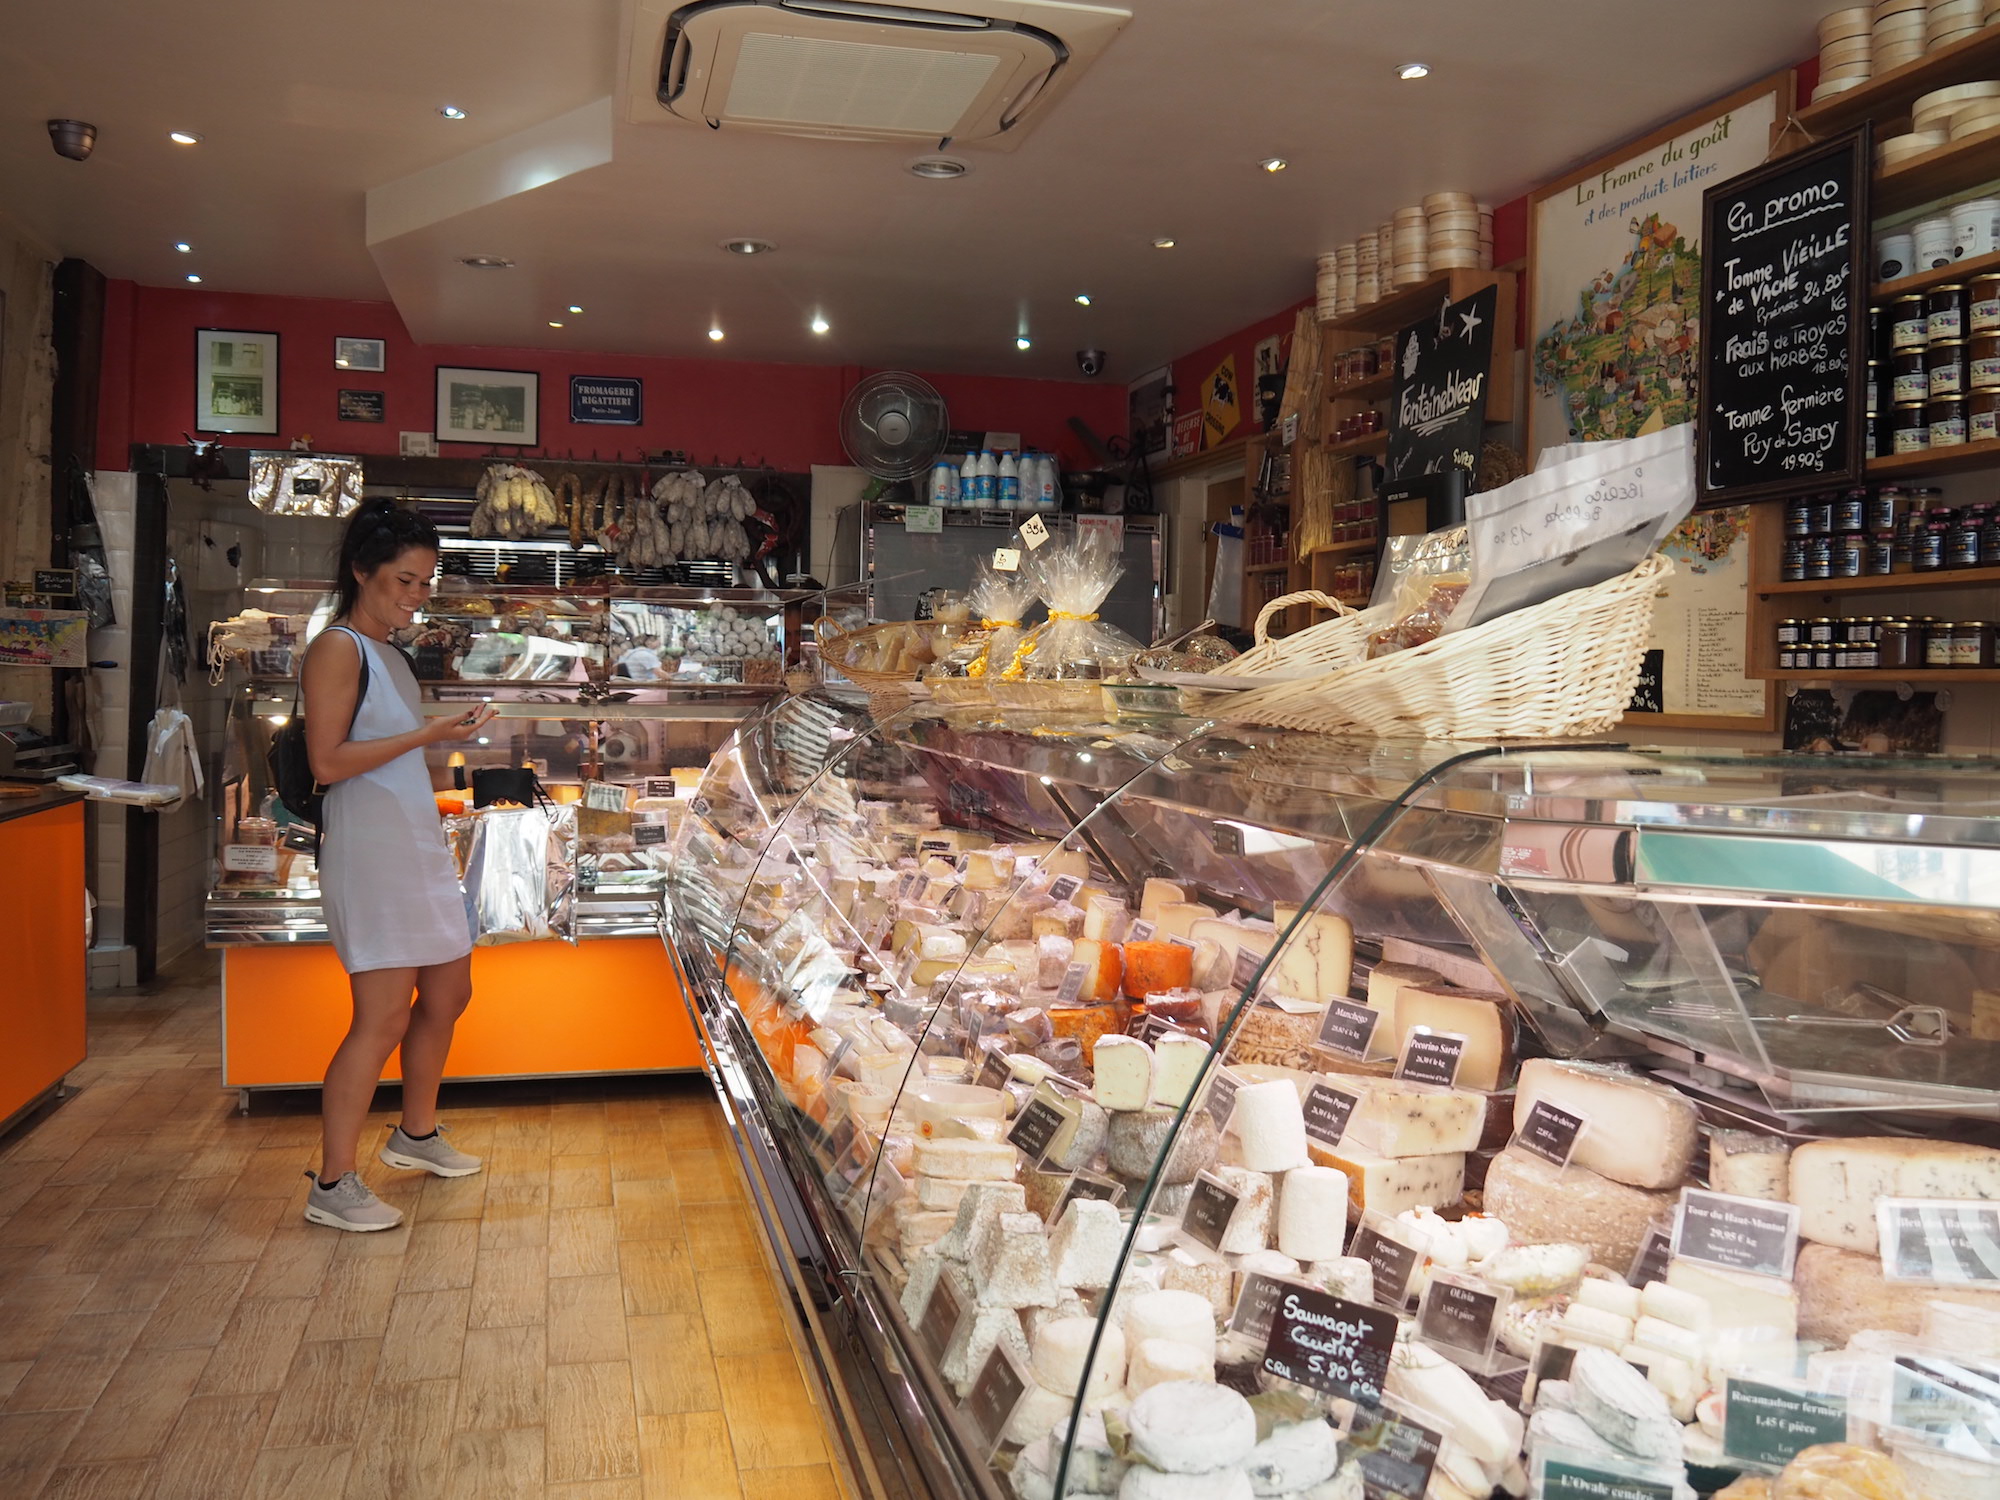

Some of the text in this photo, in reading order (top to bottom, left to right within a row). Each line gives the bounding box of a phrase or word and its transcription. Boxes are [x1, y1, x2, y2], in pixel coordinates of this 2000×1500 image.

[1576, 114, 1732, 206] La France du goût
[1584, 162, 1718, 227] et des produits laitiers
[1727, 180, 1839, 232] En promo
[1724, 257, 1773, 291] Tomme
[1728, 297, 1745, 315] de
[1750, 271, 1800, 307] VACHE
[1774, 335, 1789, 349] de
[1221, 365, 1233, 382] COW
[578, 385, 634, 396] FROMAGERIE
[1399, 368, 1484, 428] Fontainebleau
[581, 396, 631, 406] RIGATTIERI
[1725, 404, 1774, 430] Tomme
[1743, 432, 1773, 464] Puy
[1787, 421, 1839, 451] Sancy
[1335, 1007, 1368, 1024] Manchego
[1411, 1039, 1439, 1051] Pecorino
[1687, 1205, 1709, 1218] Tour
[1709, 1209, 1723, 1221] du
[1709, 1228, 1737, 1242] 29,95
[1737, 1234, 1745, 1243] €
[1458, 1310, 1476, 1322] pièce
[1732, 1390, 1842, 1417] Rocamadour fermier
[1756, 1415, 1817, 1434] 1,45 € pièce
[1562, 1474, 1609, 1496] L'Ovale
